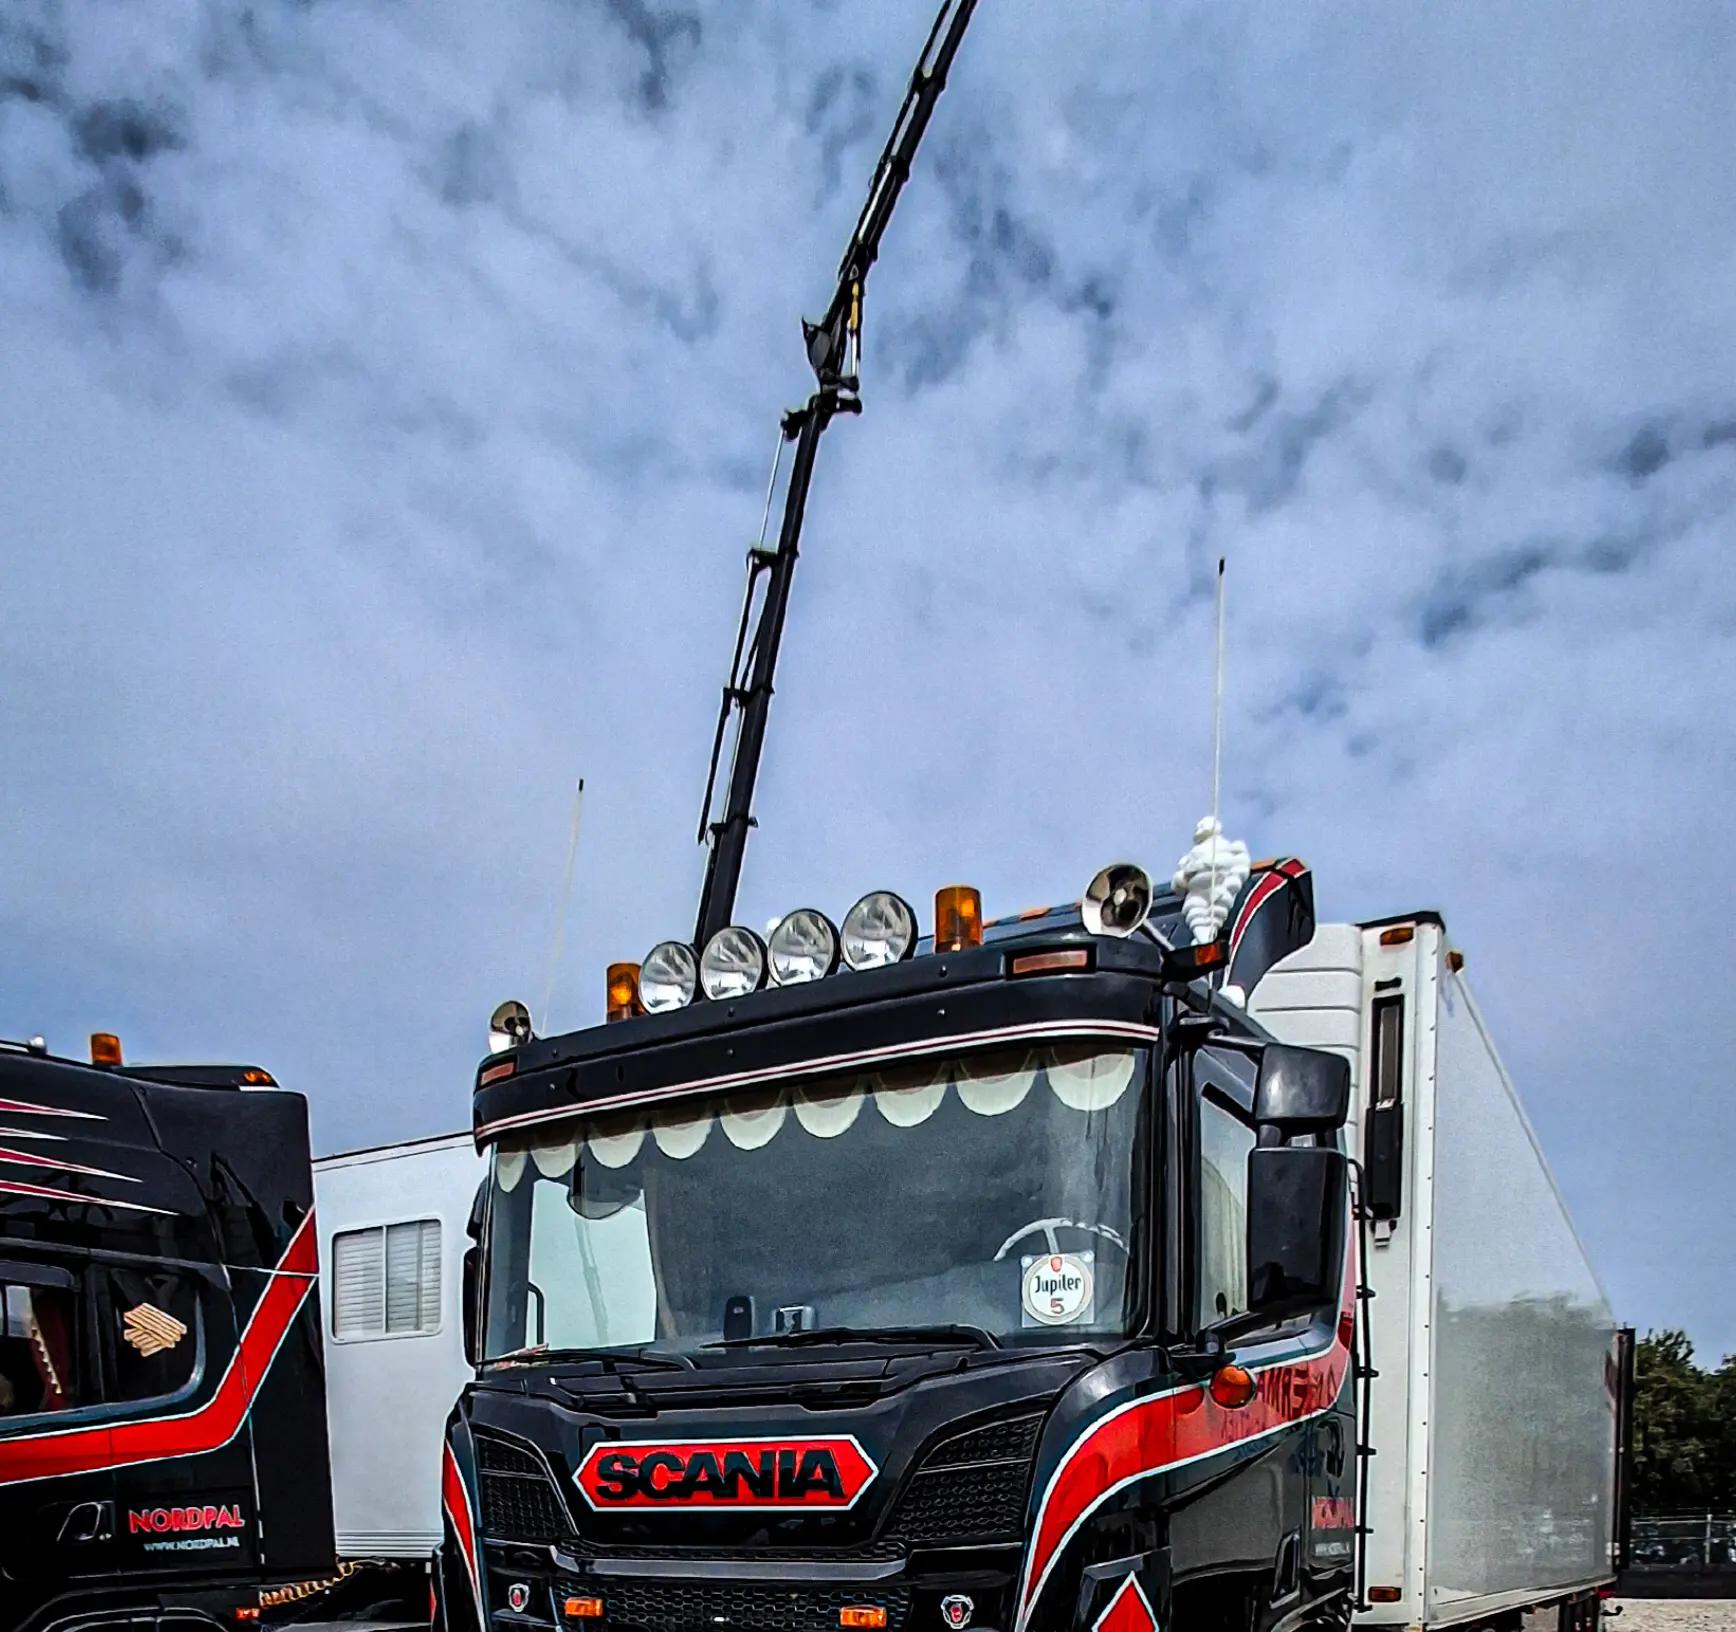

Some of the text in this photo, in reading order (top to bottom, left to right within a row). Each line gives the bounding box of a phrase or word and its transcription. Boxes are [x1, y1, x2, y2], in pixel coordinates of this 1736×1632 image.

[1050, 1297, 1065, 1315] 5
[595, 1449, 848, 1500] SCANIA
[128, 1504, 245, 1533] NORDPAL
